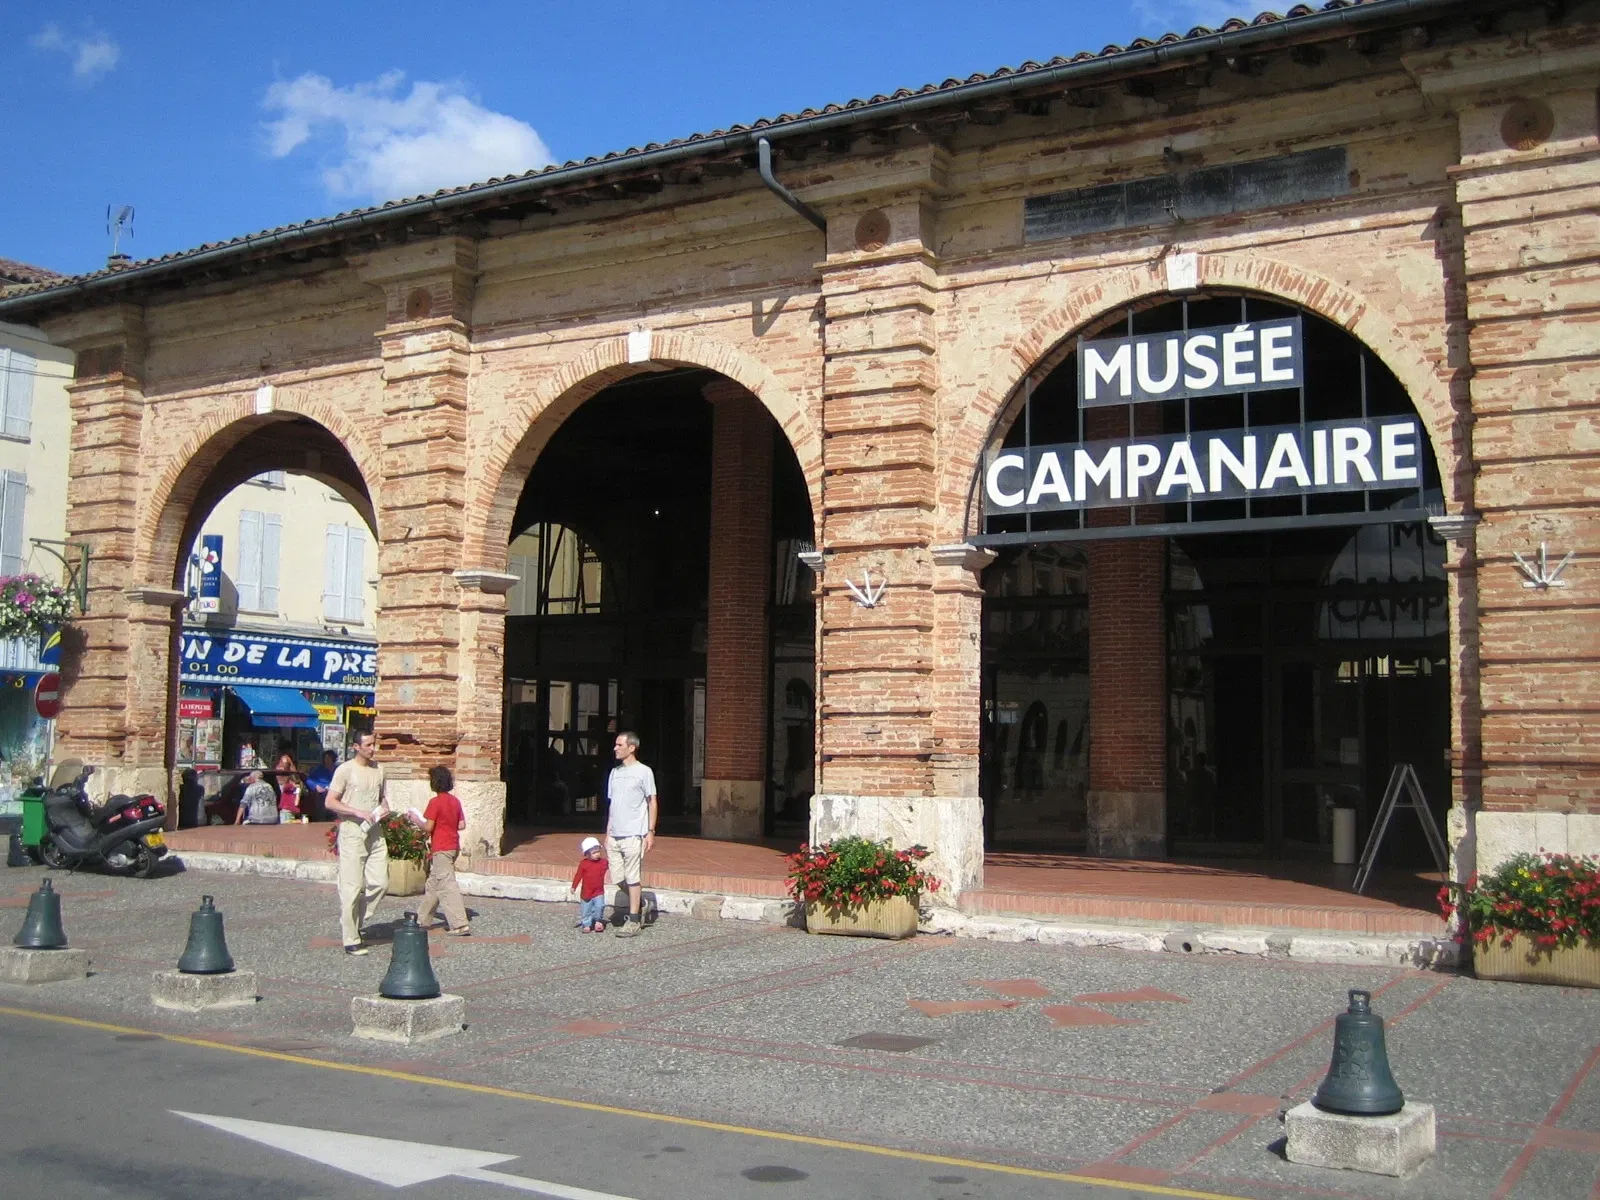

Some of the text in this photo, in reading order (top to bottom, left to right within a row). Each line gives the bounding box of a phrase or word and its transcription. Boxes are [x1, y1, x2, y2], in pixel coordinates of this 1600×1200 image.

[1083, 324, 1294, 400] MUSÉE
[985, 421, 1419, 508] CAMPANAIRE
[178, 635, 212, 660] N
[223, 641, 267, 665] DE
[277, 646, 312, 669] LA
[189, 661, 239, 675] 01 00
